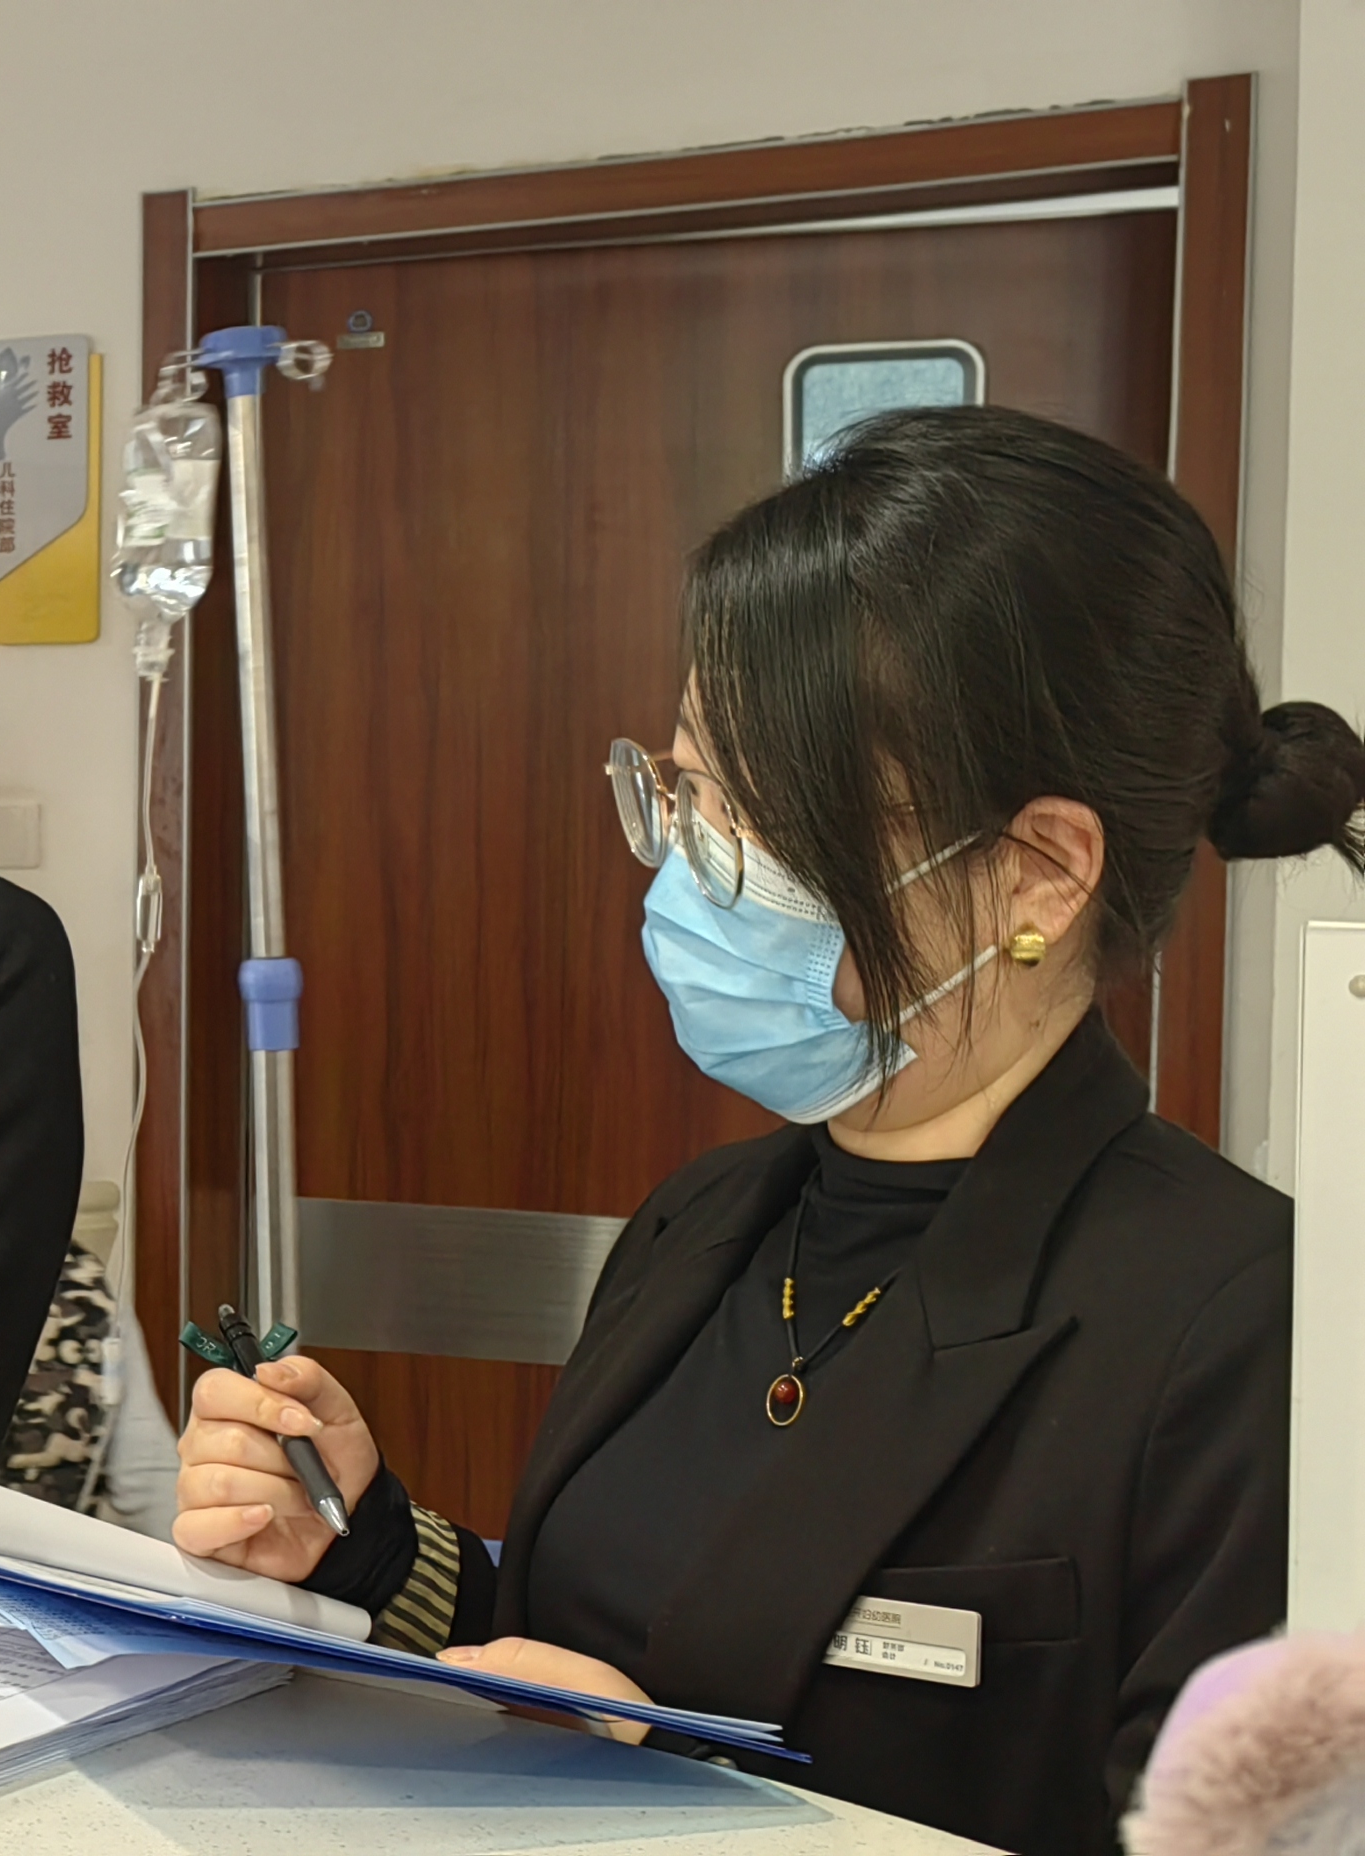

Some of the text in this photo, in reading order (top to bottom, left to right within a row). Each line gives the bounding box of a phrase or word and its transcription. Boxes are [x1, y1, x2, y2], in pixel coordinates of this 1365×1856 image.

[47, 347, 73, 440] 抢救室
[0, 462, 15, 553] 儿科住院部
